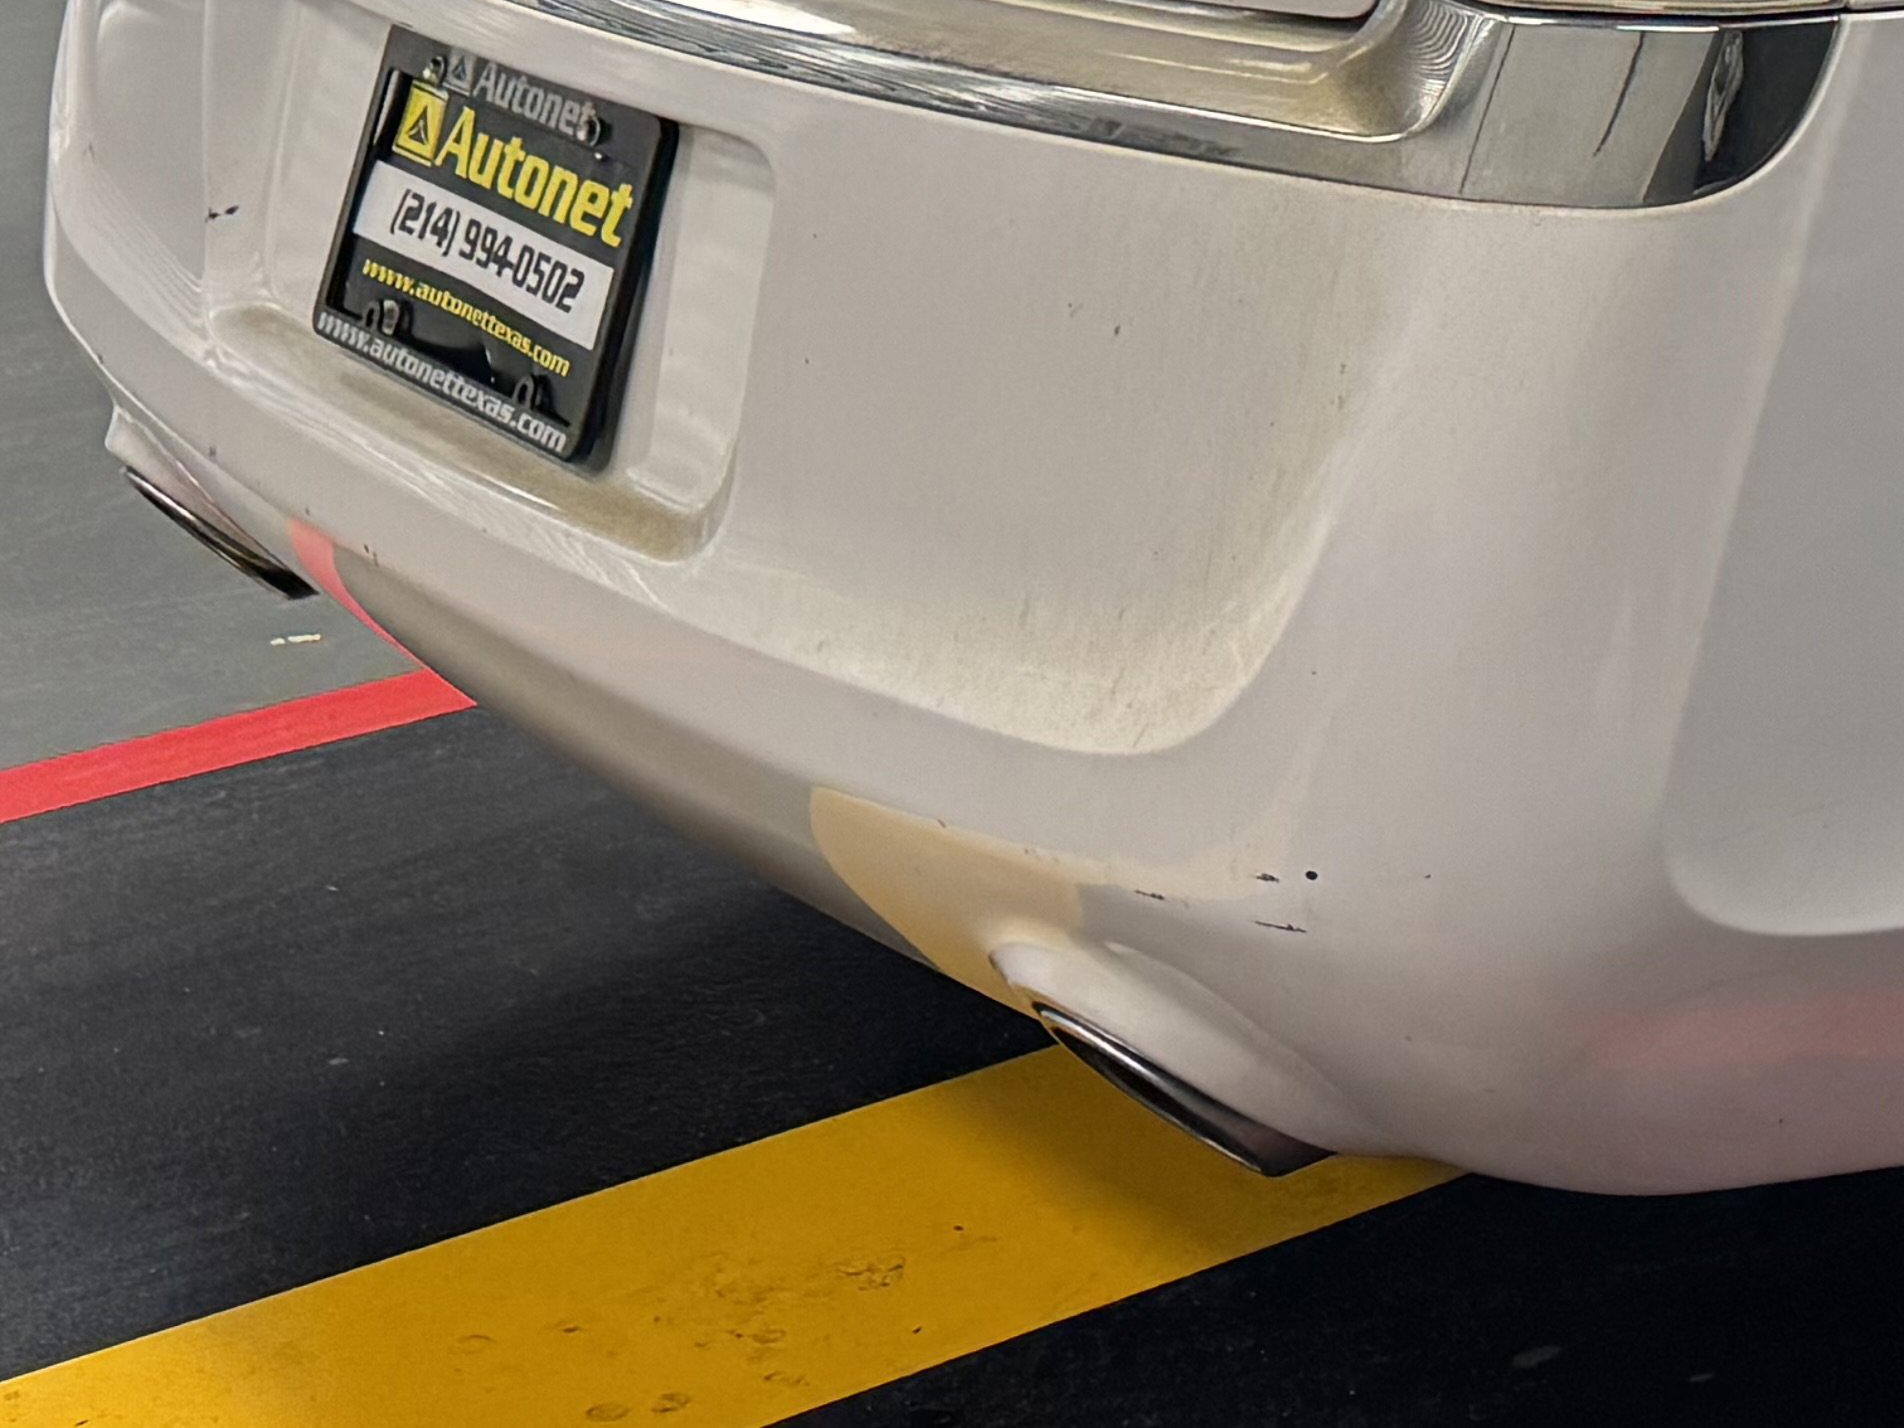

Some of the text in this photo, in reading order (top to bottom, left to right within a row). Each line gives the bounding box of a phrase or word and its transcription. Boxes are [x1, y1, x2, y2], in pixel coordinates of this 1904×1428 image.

[434, 105, 634, 248] Autonet
[361, 258, 572, 378] www.autonettexas.com
[389, 188, 586, 314] (214) 994-0502
[317, 311, 568, 454] www.autonettexas.com
